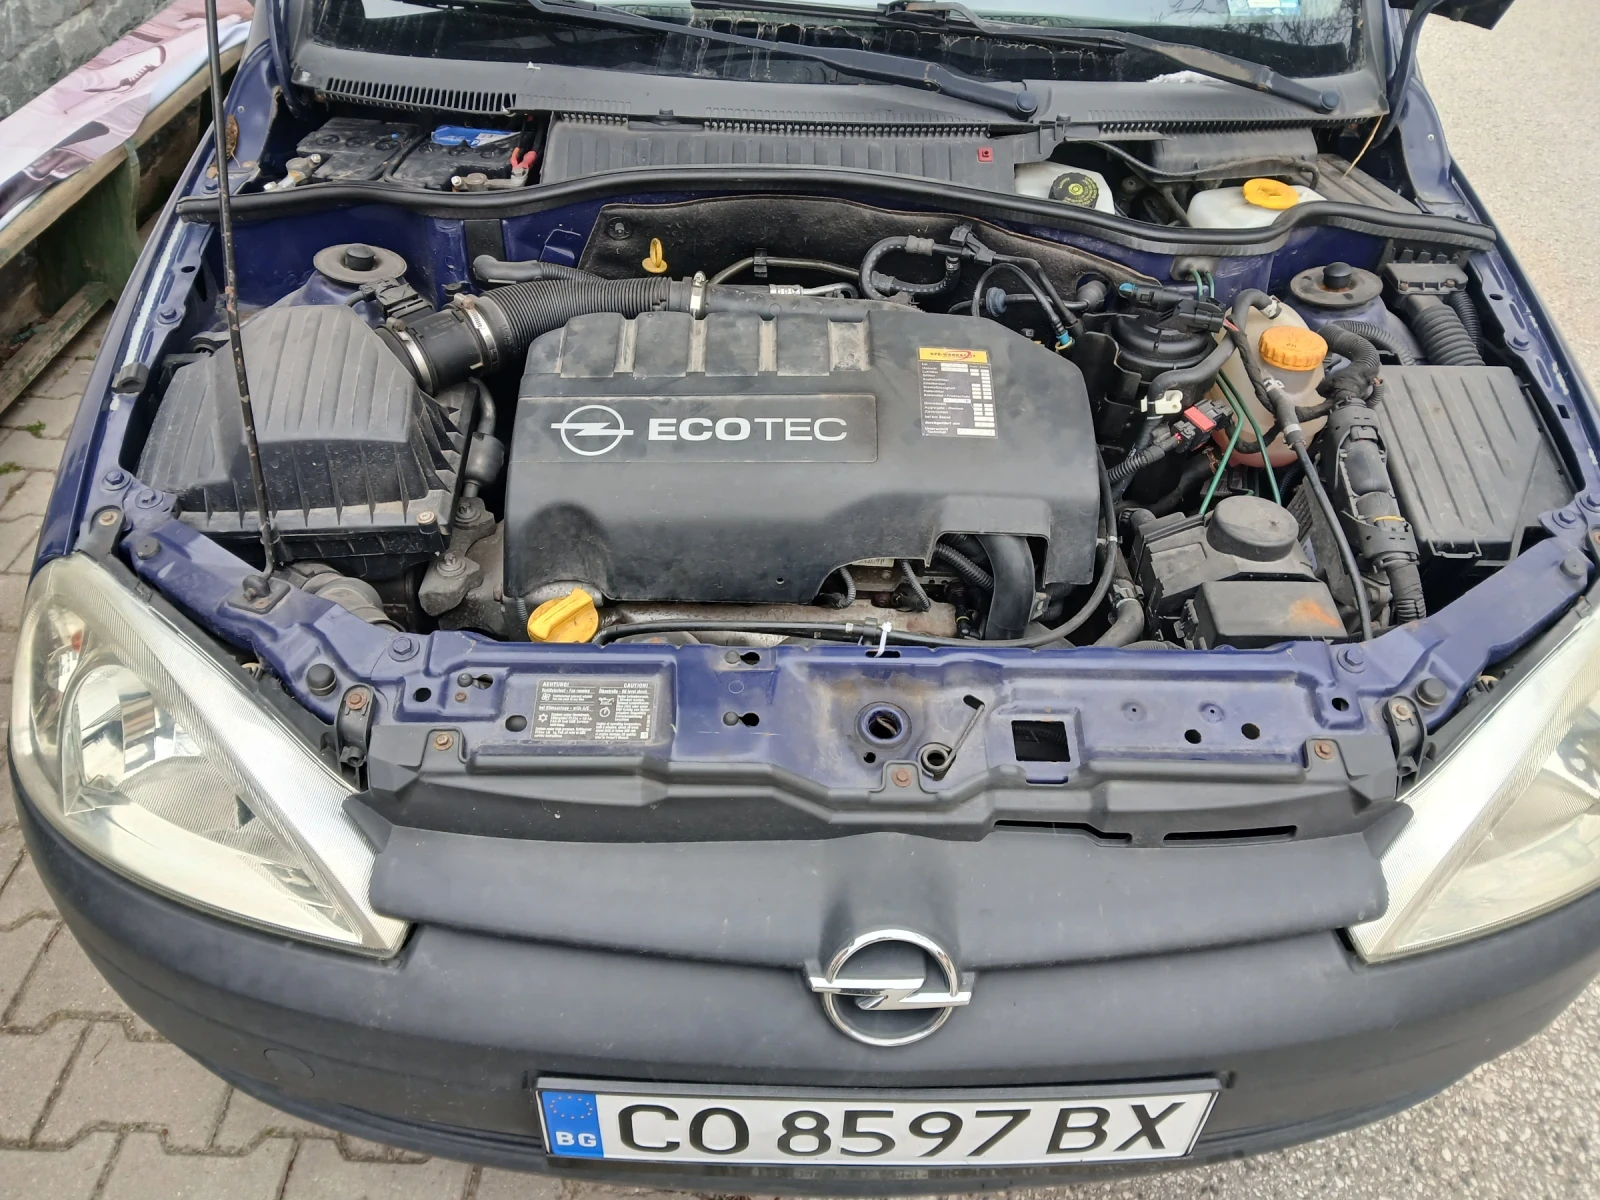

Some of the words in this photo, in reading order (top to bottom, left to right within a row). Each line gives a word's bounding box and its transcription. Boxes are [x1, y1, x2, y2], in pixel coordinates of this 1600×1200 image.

[648, 417, 848, 442] ECOTEC
[555, 1131, 597, 1148] BG
[617, 1104, 750, 1156] CO
[777, 1108, 1032, 1158] 8597
[1045, 1101, 1187, 1155] BX
